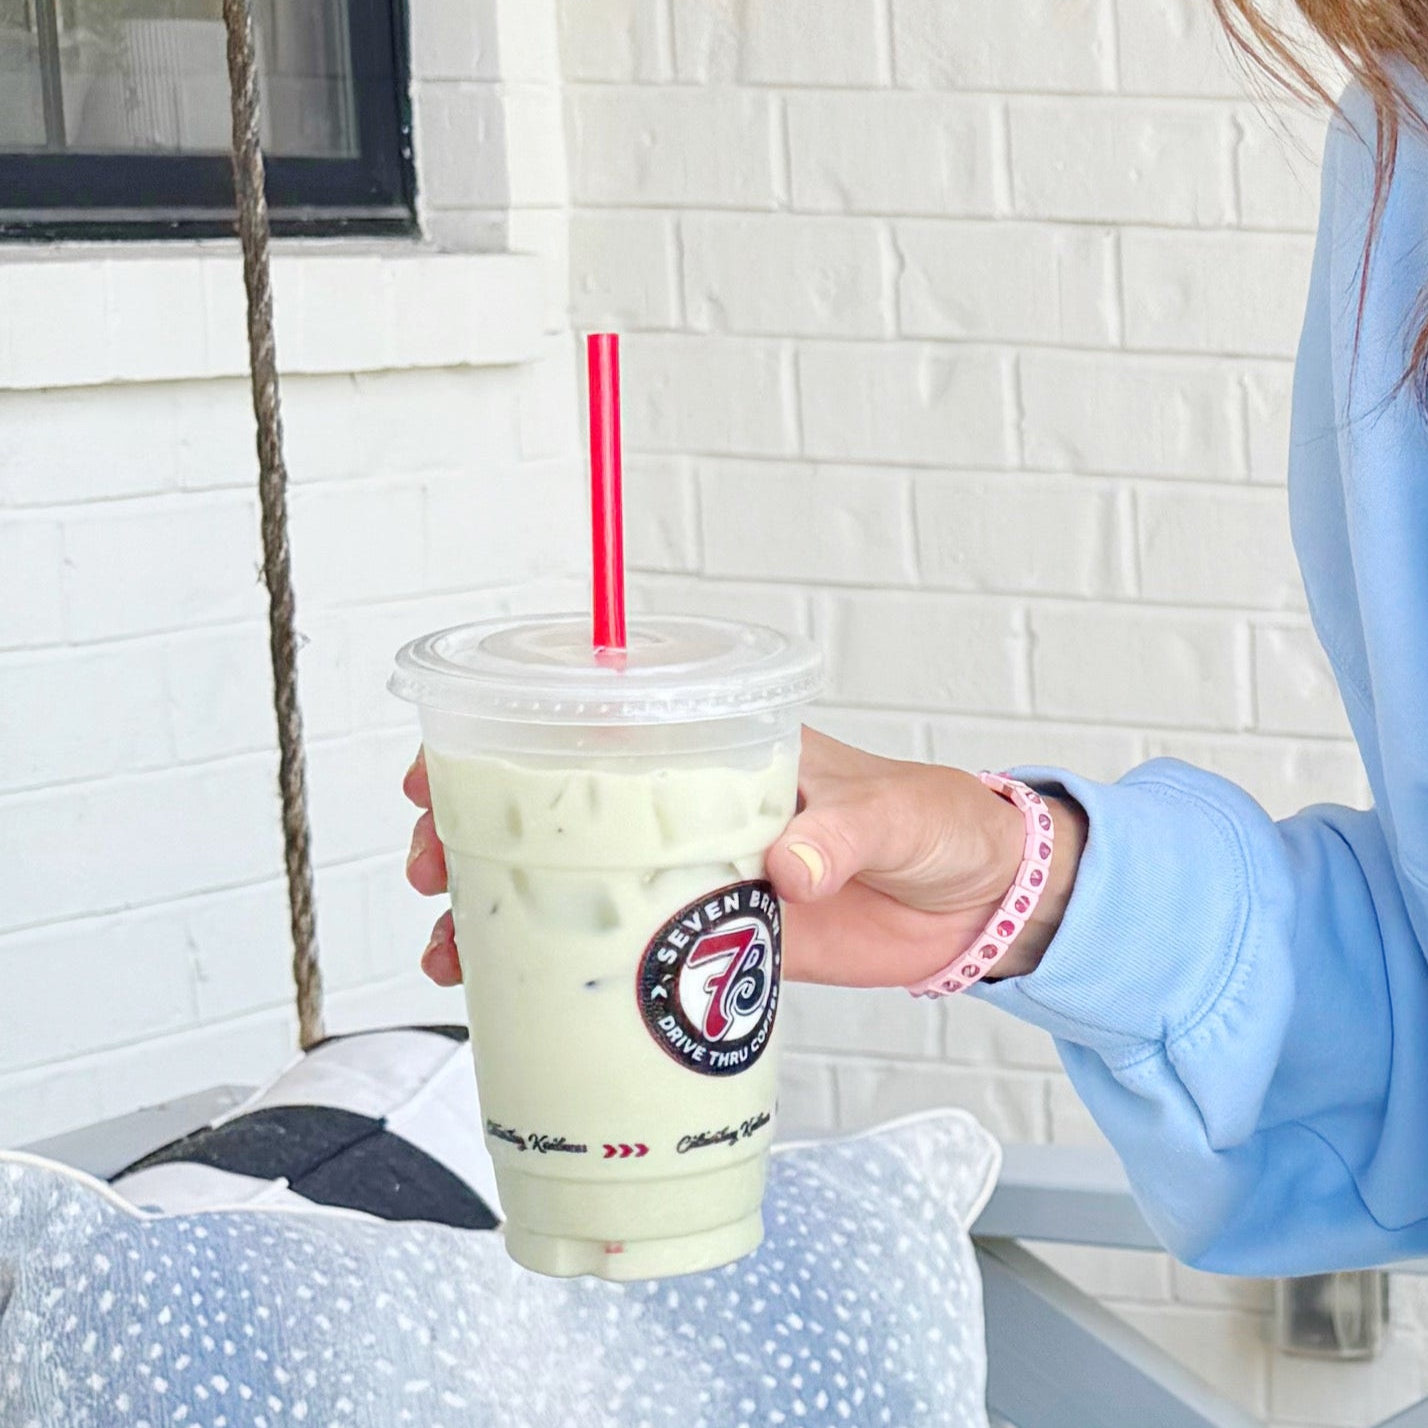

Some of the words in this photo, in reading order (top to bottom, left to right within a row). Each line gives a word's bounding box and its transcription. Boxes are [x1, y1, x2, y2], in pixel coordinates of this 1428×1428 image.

[656, 891, 740, 965] SEVEN
[657, 1014, 707, 1061] DRIVE
[709, 1046, 749, 1067] THRU
